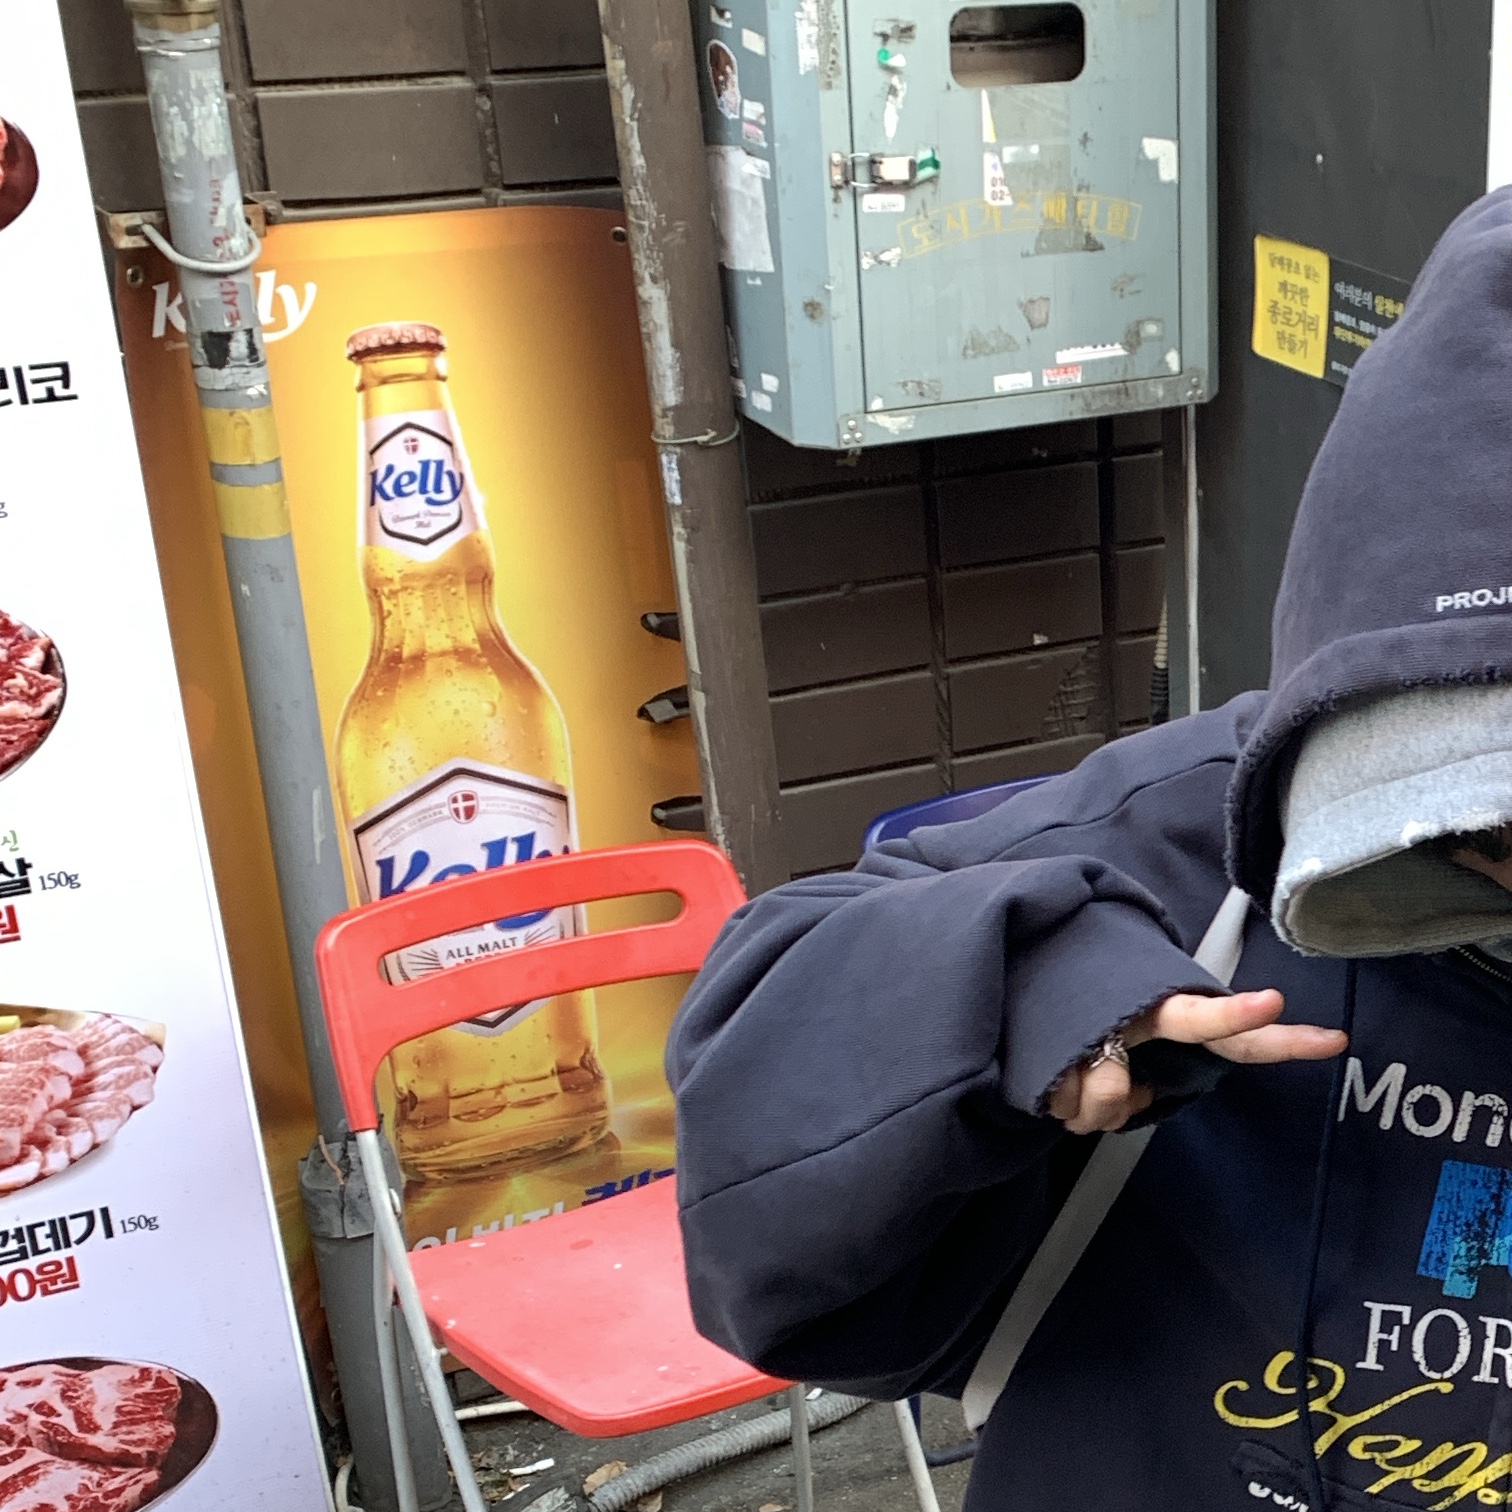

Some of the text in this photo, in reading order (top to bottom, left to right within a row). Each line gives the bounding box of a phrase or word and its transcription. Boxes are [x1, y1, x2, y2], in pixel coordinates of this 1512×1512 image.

[152, 268, 318, 345] Kly
[1267, 300, 1320, 340] 종로거리
[369, 458, 465, 507] Kelly
[38, 871, 82, 891] 150g
[446, 947, 479, 961] ALL
[477, 936, 520, 955] MALT
[119, 1214, 160, 1235] 150g
[0, 1255, 80, 1308] 0원
